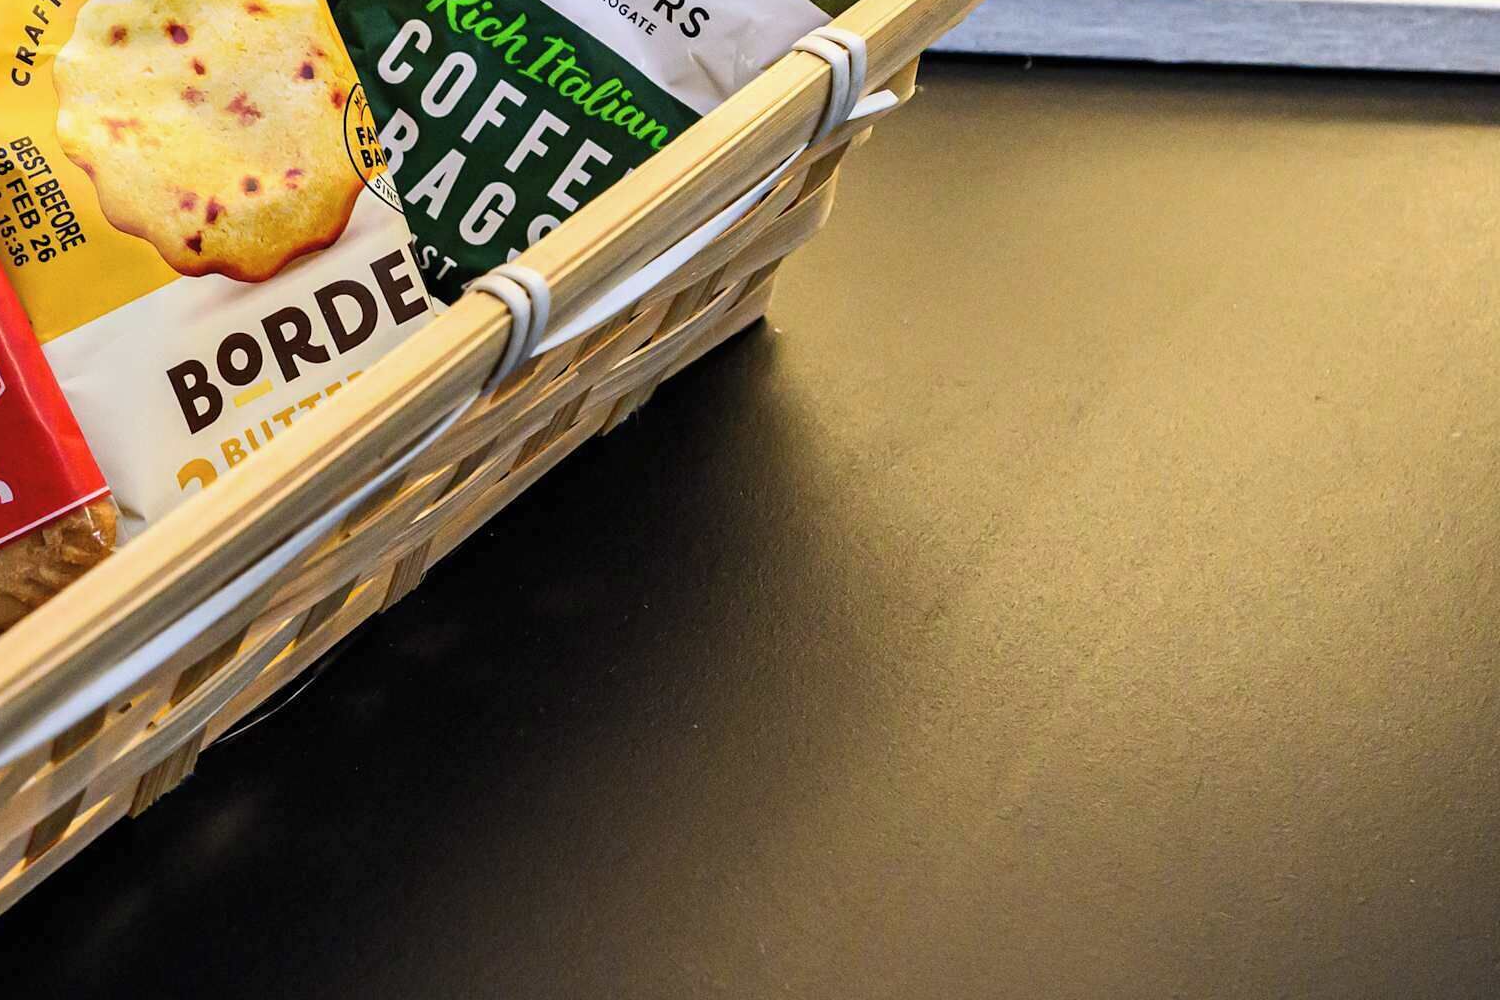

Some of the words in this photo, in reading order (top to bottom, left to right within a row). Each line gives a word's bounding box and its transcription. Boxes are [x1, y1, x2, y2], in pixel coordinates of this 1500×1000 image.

[377, 18, 636, 212] COFFE
[517, 36, 669, 151] Italian
[6, 178, 41, 229] FEB
[30, 234, 57, 262] 26
[10, 136, 52, 180] BEST
[35, 179, 86, 252] BEFORE
